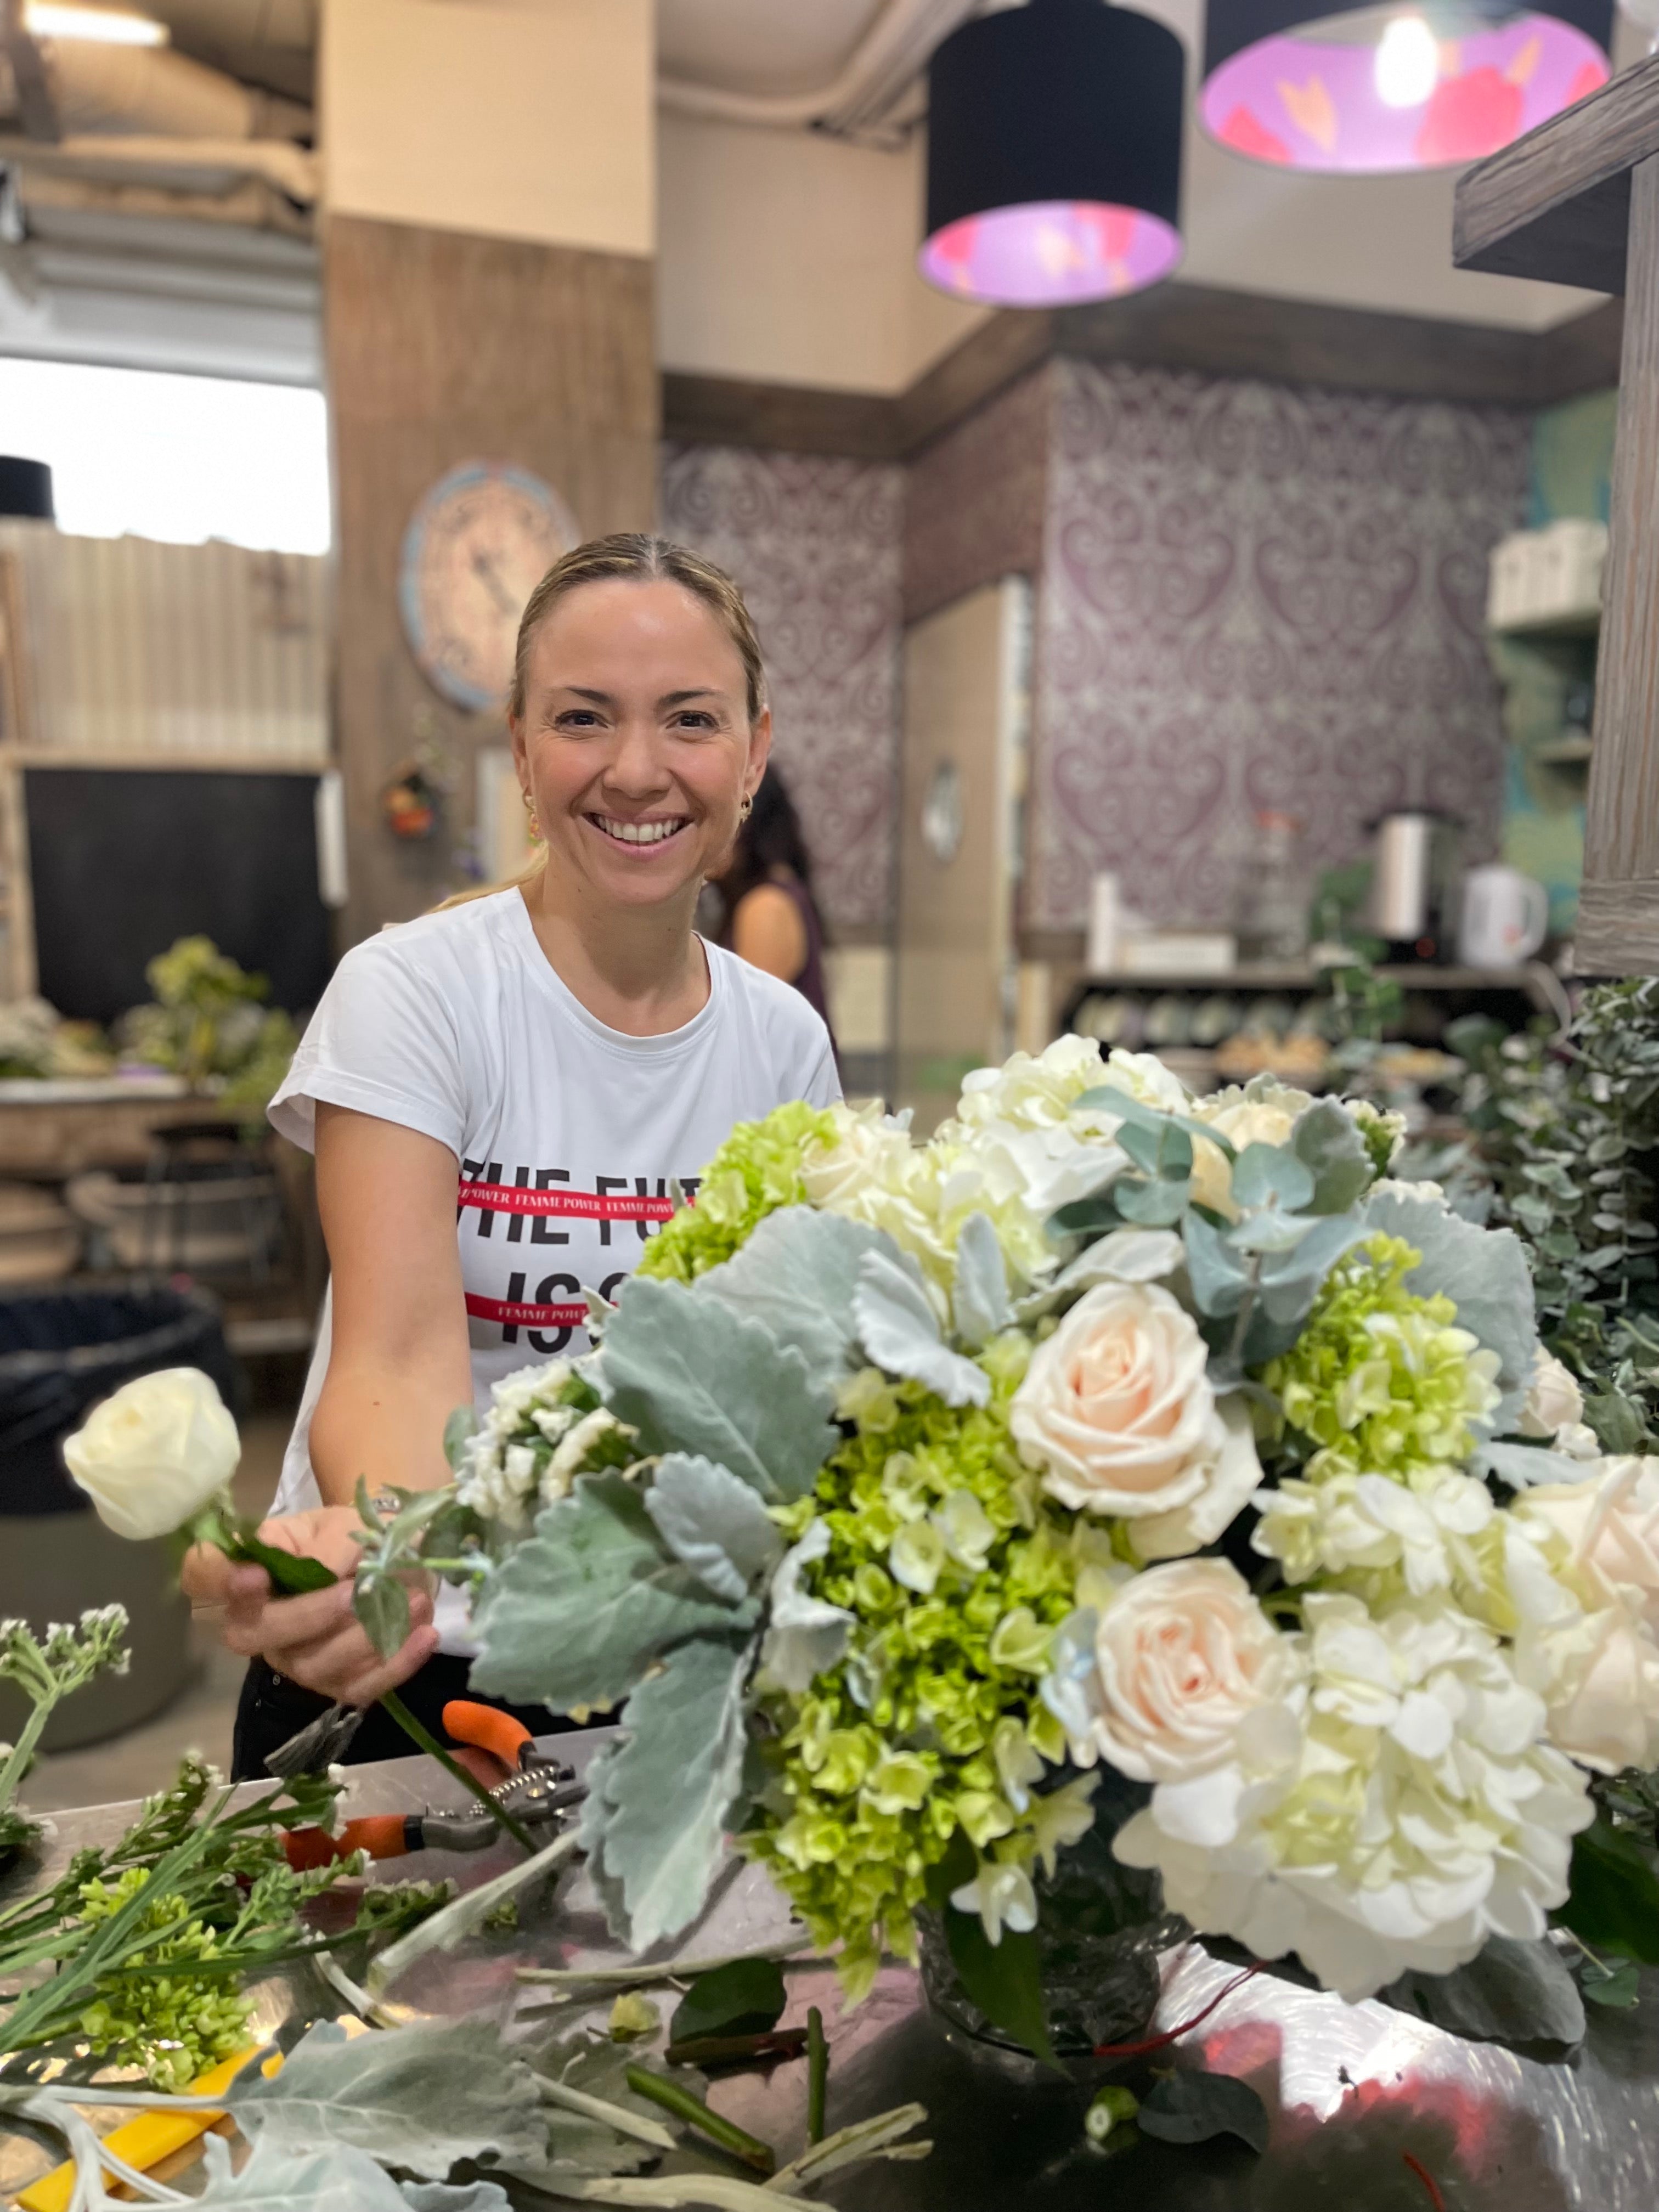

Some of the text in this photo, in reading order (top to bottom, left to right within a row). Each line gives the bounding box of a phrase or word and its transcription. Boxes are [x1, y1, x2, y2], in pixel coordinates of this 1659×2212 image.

[515, 1194, 561, 1208] FEMME
[563, 1197, 601, 1211] POWER
[606, 1201, 646, 1213] FEMME
[498, 1307, 549, 1320] FEMME
[502, 1272, 581, 1354] IS
